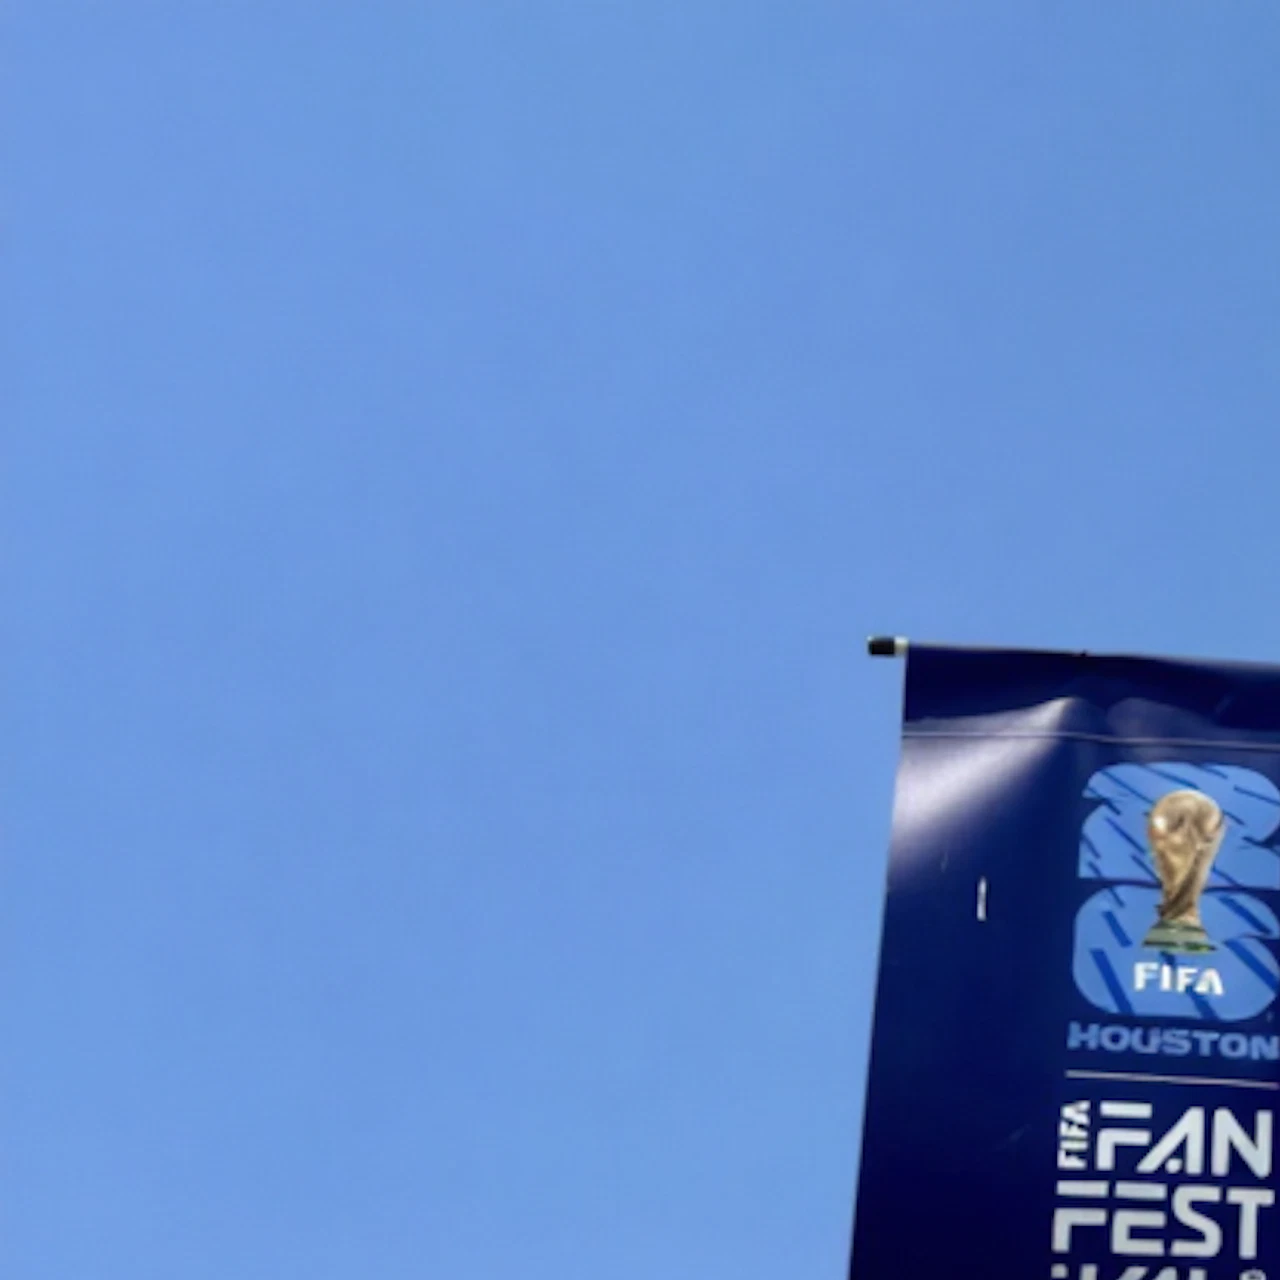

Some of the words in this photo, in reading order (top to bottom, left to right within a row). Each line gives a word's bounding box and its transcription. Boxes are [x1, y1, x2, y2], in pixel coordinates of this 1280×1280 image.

[1133, 961, 1224, 996] FIFA
[1057, 1099, 1091, 1170] FIFA
[1095, 1099, 1274, 1179] FAN
[1051, 1179, 1276, 1260] FEST
